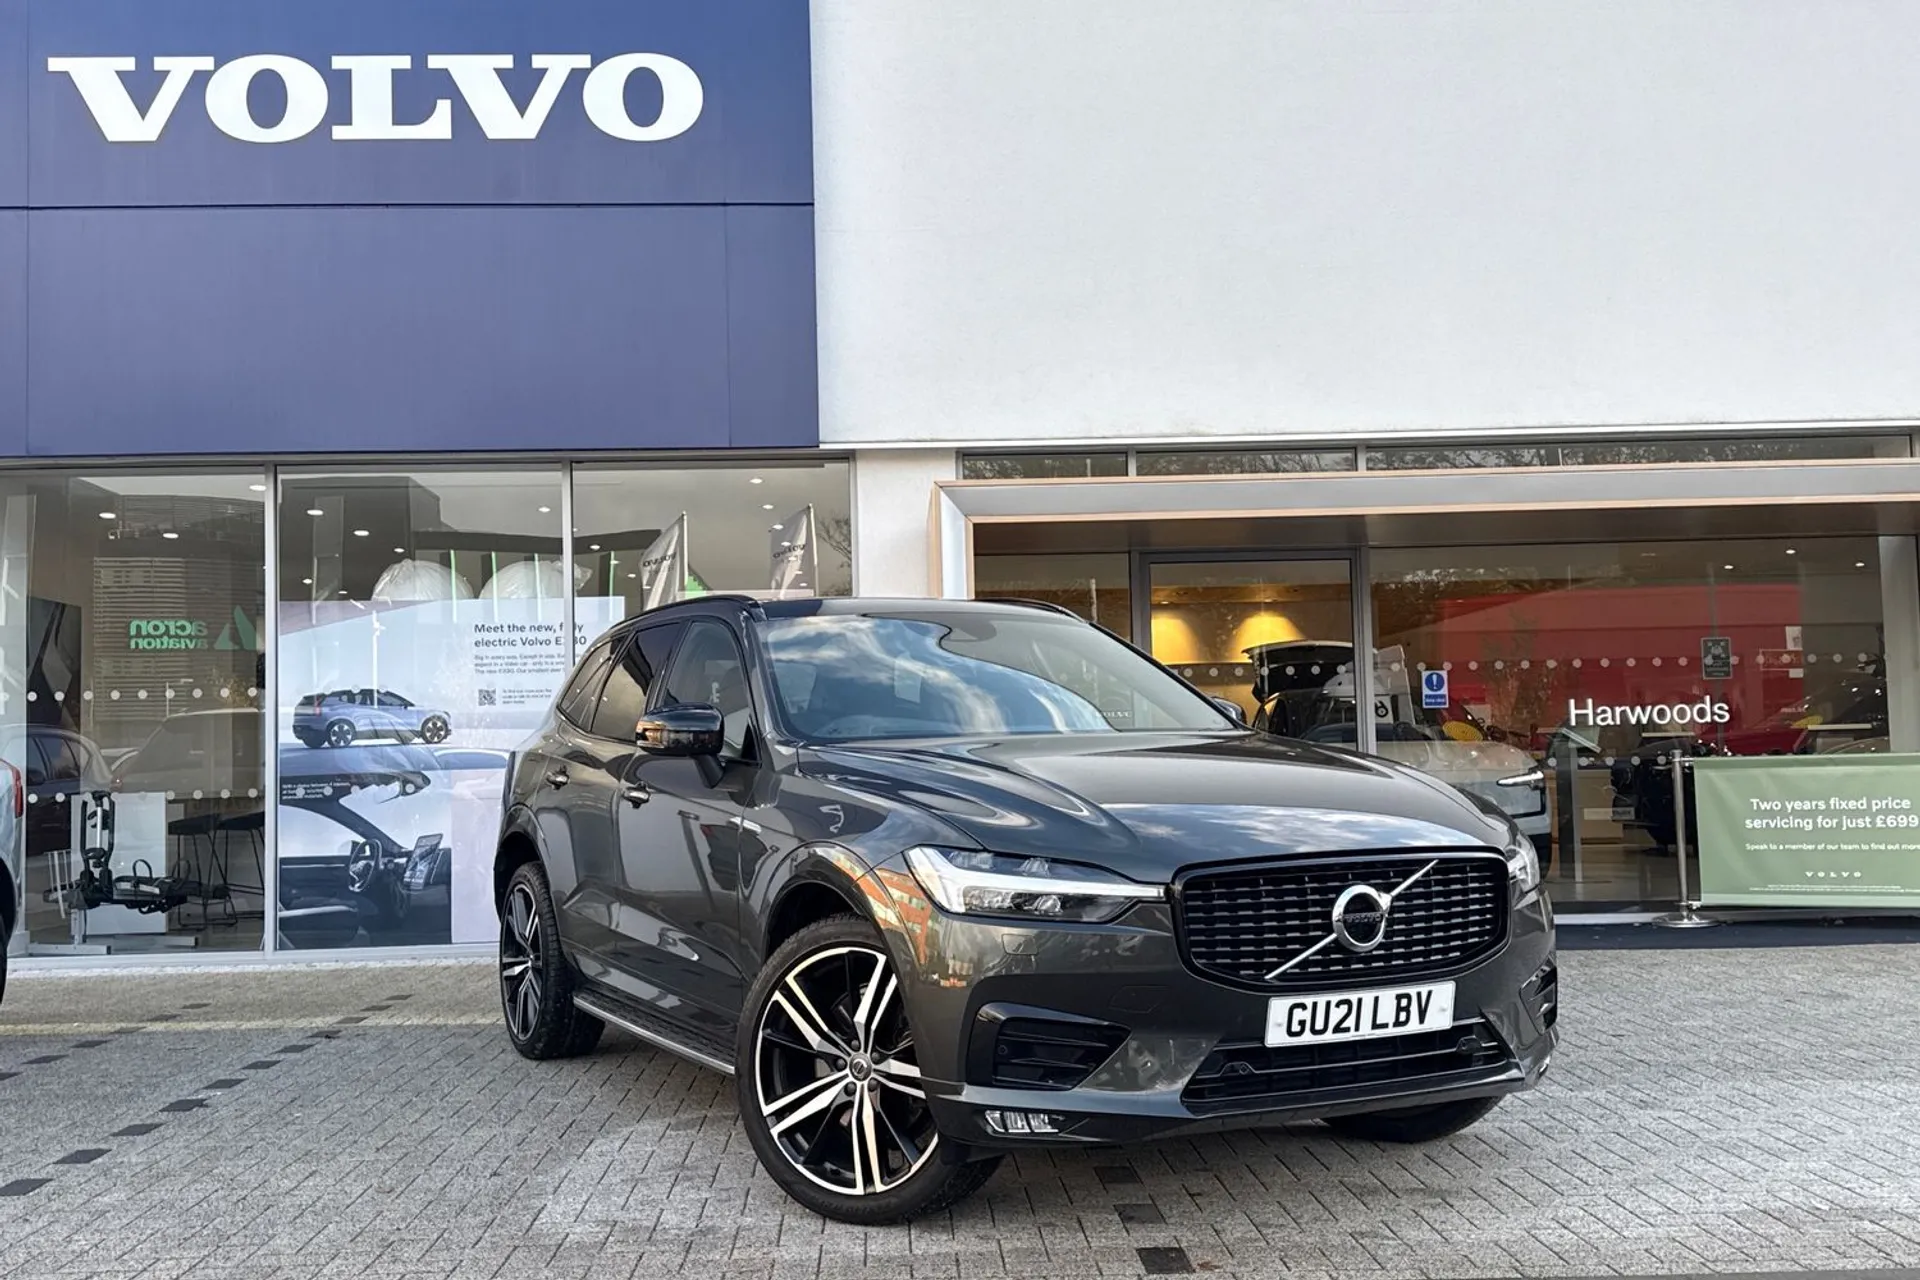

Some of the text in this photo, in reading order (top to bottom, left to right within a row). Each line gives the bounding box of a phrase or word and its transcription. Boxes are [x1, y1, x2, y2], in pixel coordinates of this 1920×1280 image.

[48, 53, 704, 143] VOLVO
[474, 623, 504, 634] Meet
[508, 622, 527, 633] the
[529, 623, 557, 634] new,
[474, 637, 517, 648] electric
[519, 636, 552, 647] Volvo
[1568, 695, 1730, 727] Harwoods
[1750, 796, 1911, 813] Two years fixed price
[1745, 815, 1919, 831] servicing for just £699
[1286, 990, 1433, 1038] GU21 LBV
